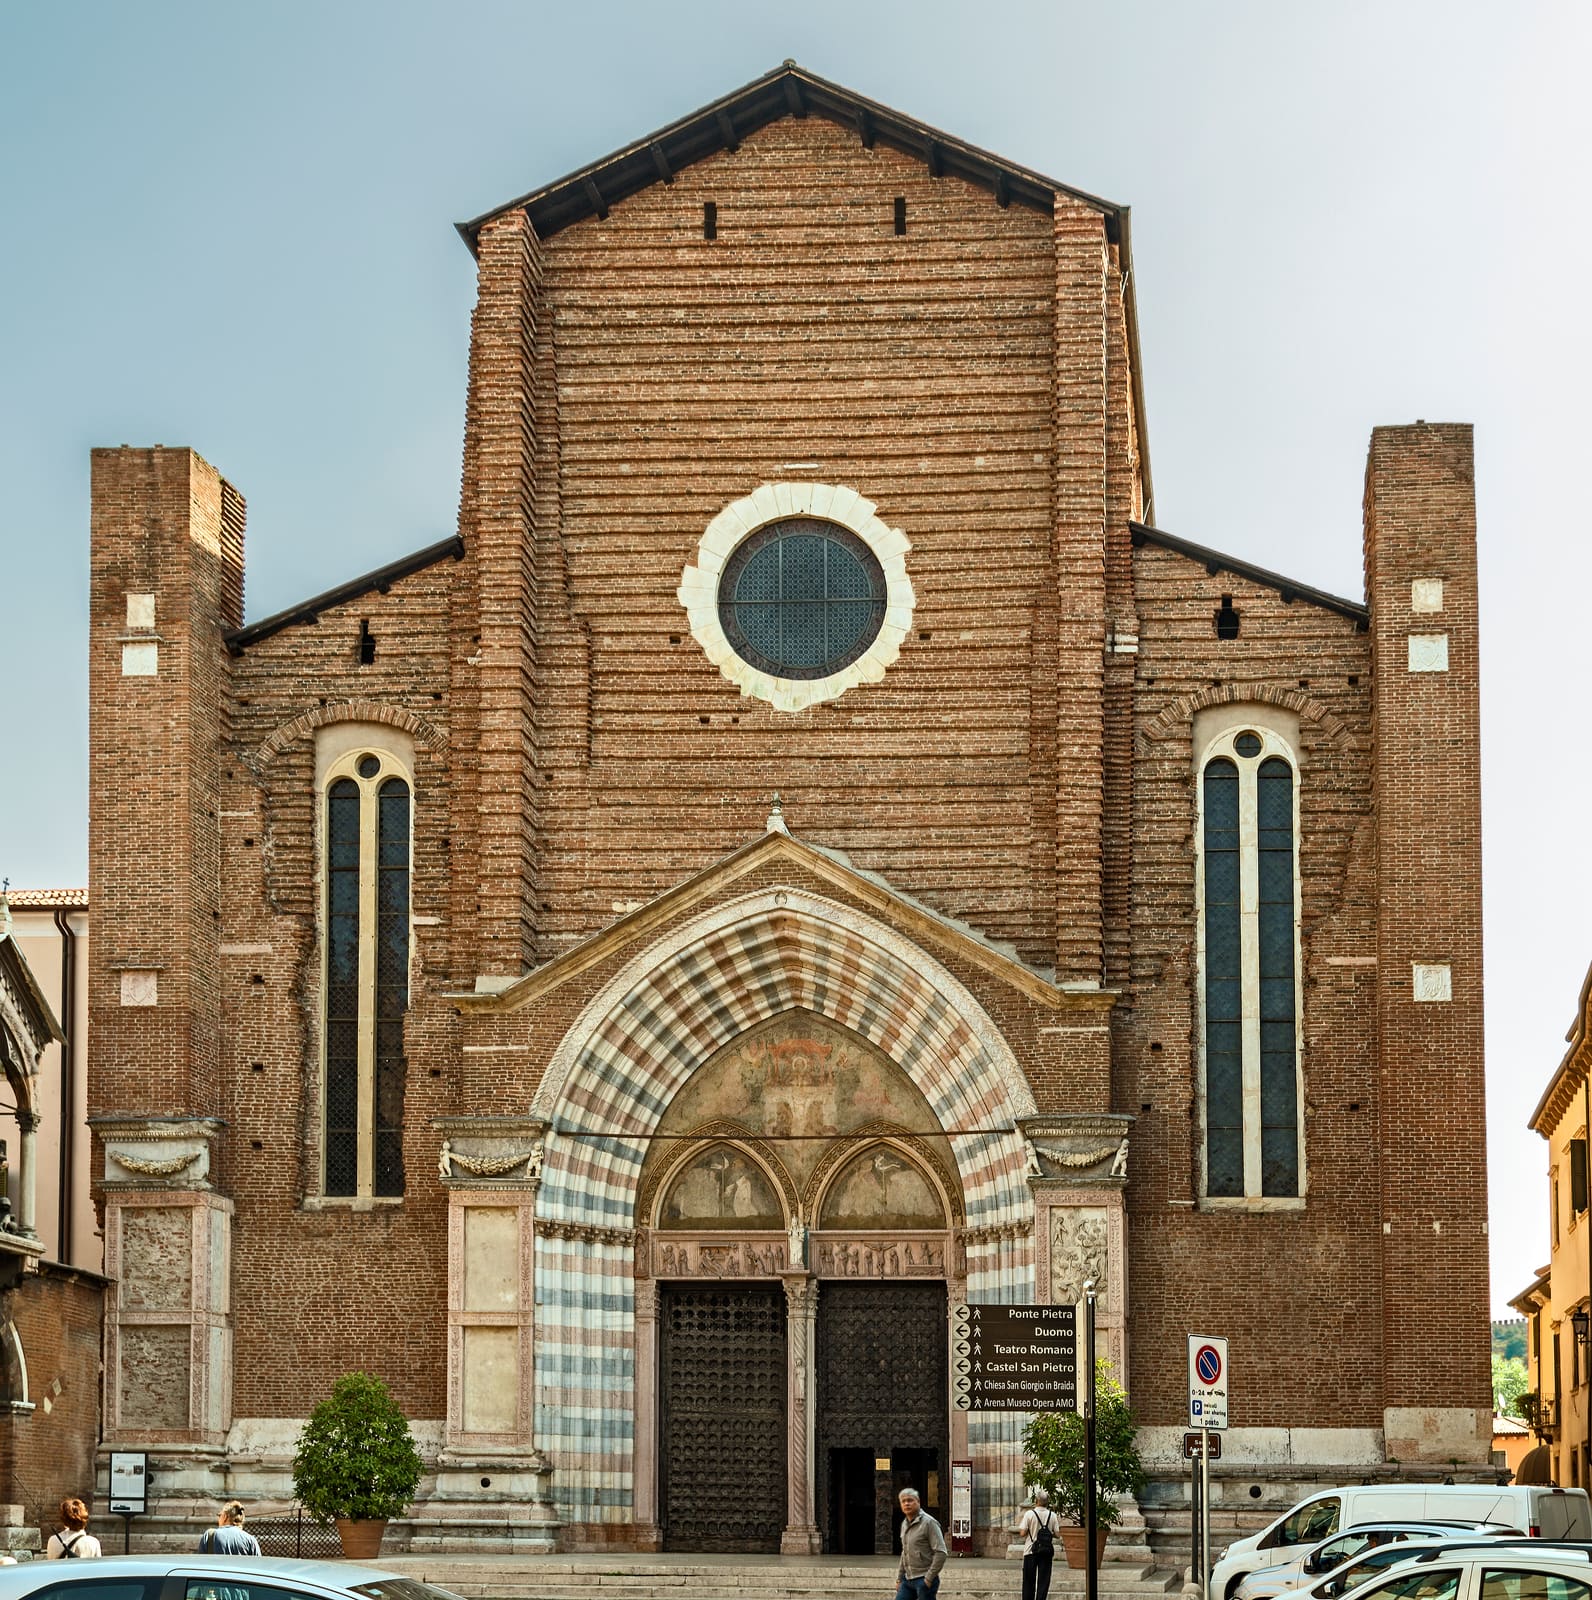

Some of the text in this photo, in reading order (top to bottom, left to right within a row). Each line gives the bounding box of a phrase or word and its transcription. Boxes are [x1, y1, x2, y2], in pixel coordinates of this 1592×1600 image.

[1009, 1309, 1073, 1319] Ponte Pietra
[1035, 1327, 1073, 1337] Duomo
[994, 1344, 1073, 1354] Teatro Romano
[986, 1362, 1074, 1372] Castel San Pietro
[984, 1380, 1075, 1392] Chiesa San Giorgio in Braida
[984, 1398, 1074, 1409] Arena Museo Opera AMO
[1194, 1402, 1200, 1413] P
